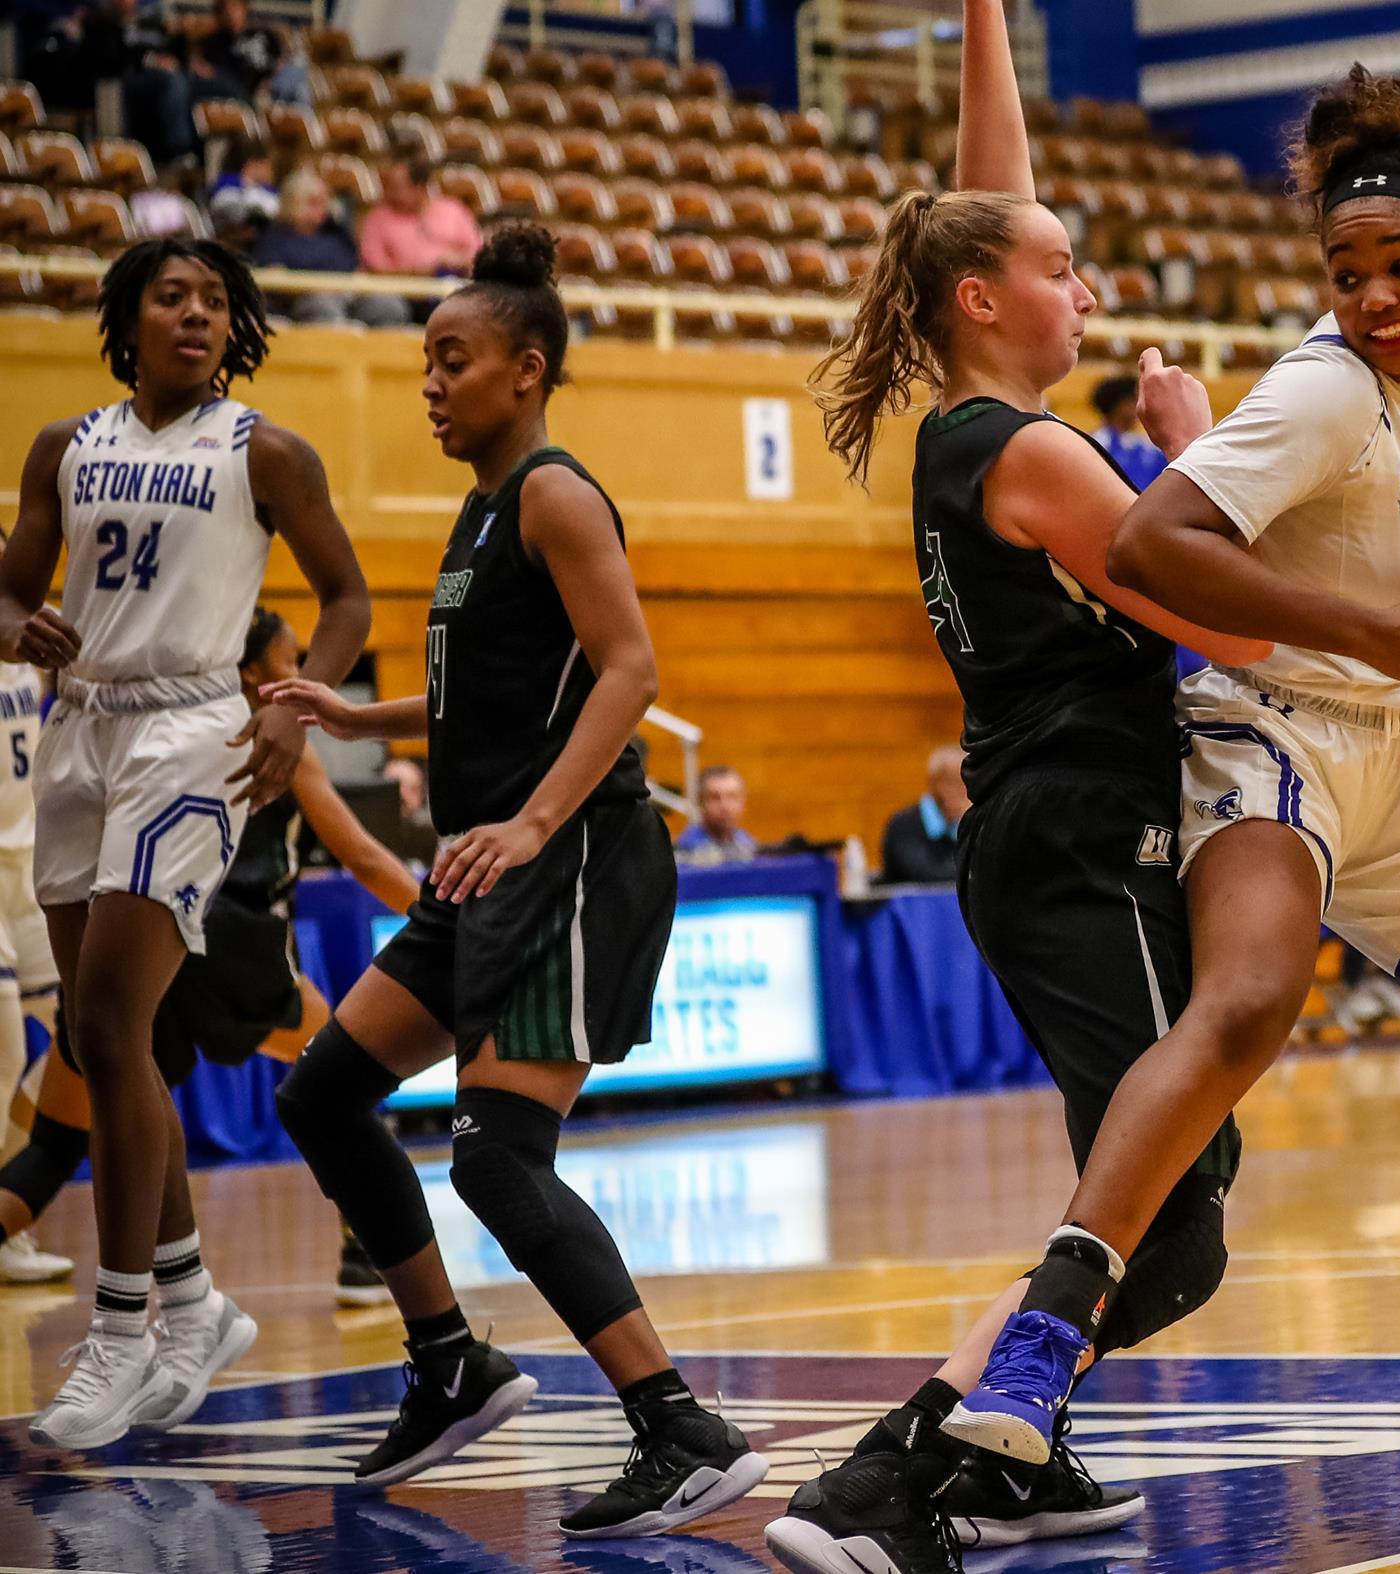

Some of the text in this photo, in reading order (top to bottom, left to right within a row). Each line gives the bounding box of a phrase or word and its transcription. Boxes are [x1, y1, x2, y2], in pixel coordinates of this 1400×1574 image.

[74, 461, 216, 514] SETON HALL
[95, 518, 164, 592] 24
[10, 731, 28, 779] 5
[675, 931, 769, 990] HALL
[652, 996, 739, 1056] ATES
